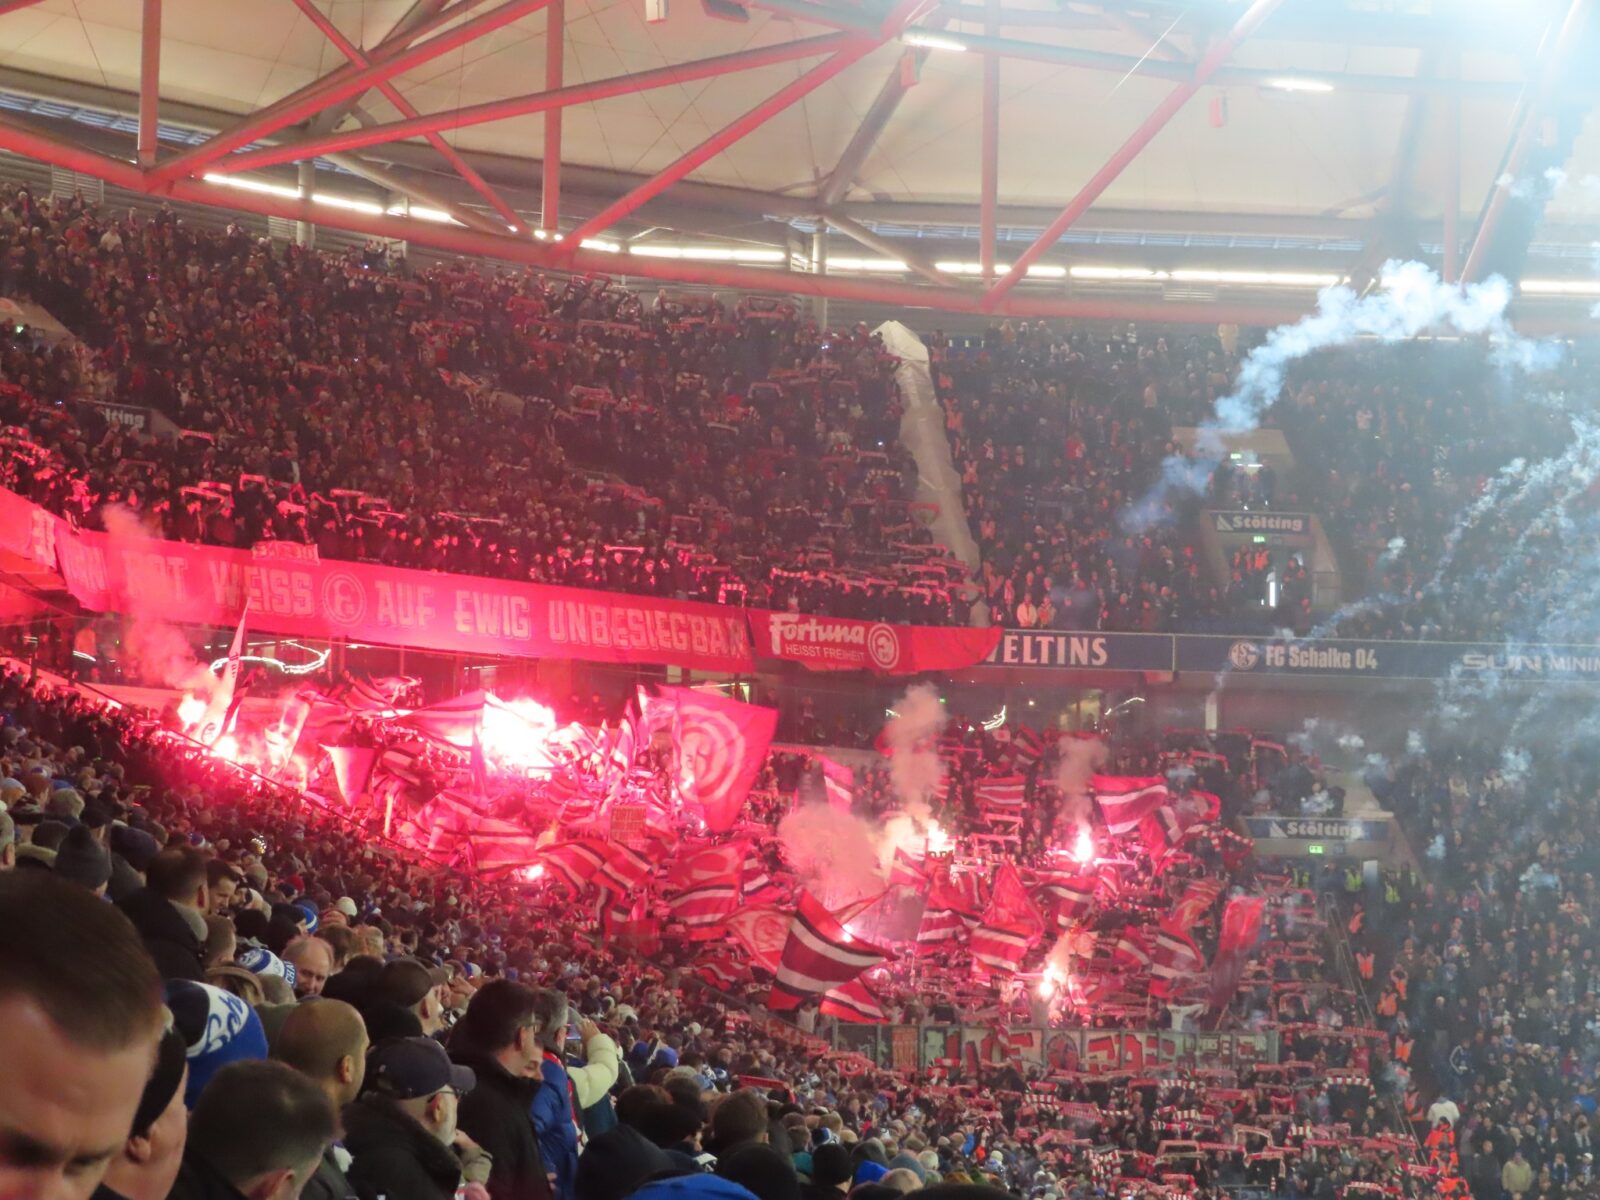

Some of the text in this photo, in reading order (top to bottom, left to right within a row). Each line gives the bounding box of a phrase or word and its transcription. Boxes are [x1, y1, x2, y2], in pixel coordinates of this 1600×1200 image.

[104, 408, 145, 428] lting
[1232, 515, 1303, 532] Stölting
[208, 559, 314, 617] WEISS
[375, 580, 435, 629] AUF
[454, 589, 531, 639] EWIG
[549, 600, 748, 656] UNBESIEGBAR
[768, 613, 866, 656] Fortuna
[785, 643, 821, 657] HEISST
[1265, 645, 1285, 667] FC
[1288, 645, 1352, 669] Schalke
[1355, 648, 1378, 670] 04
[1287, 821, 1364, 838] Stölting
